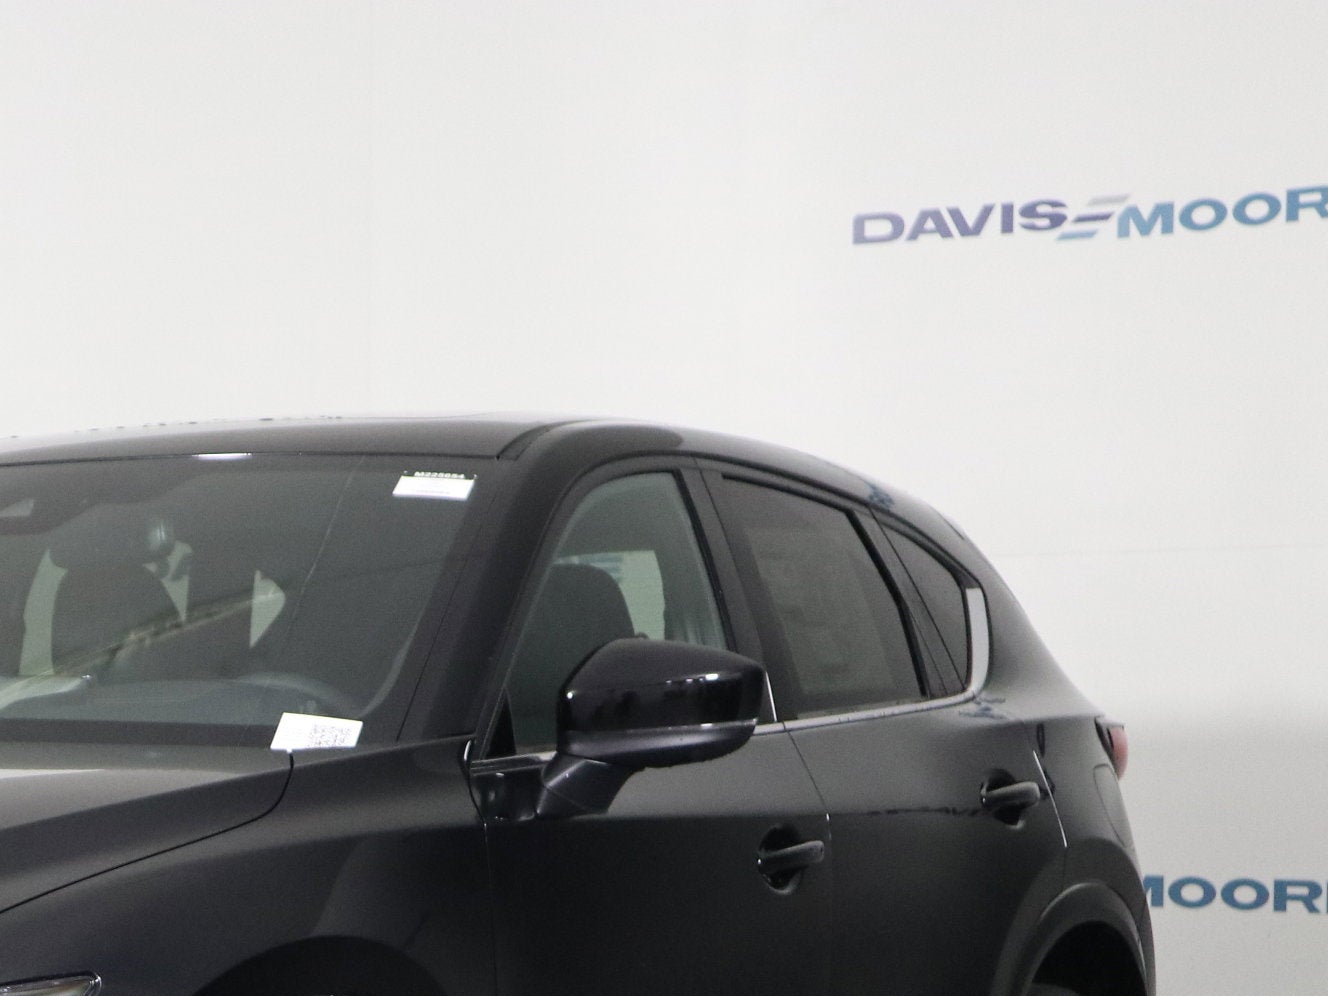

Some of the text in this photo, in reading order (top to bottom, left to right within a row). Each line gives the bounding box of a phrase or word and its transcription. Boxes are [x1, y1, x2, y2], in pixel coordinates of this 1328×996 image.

[853, 185, 1328, 244] DAVIS MOOR
[1142, 873, 1328, 913] OOR
